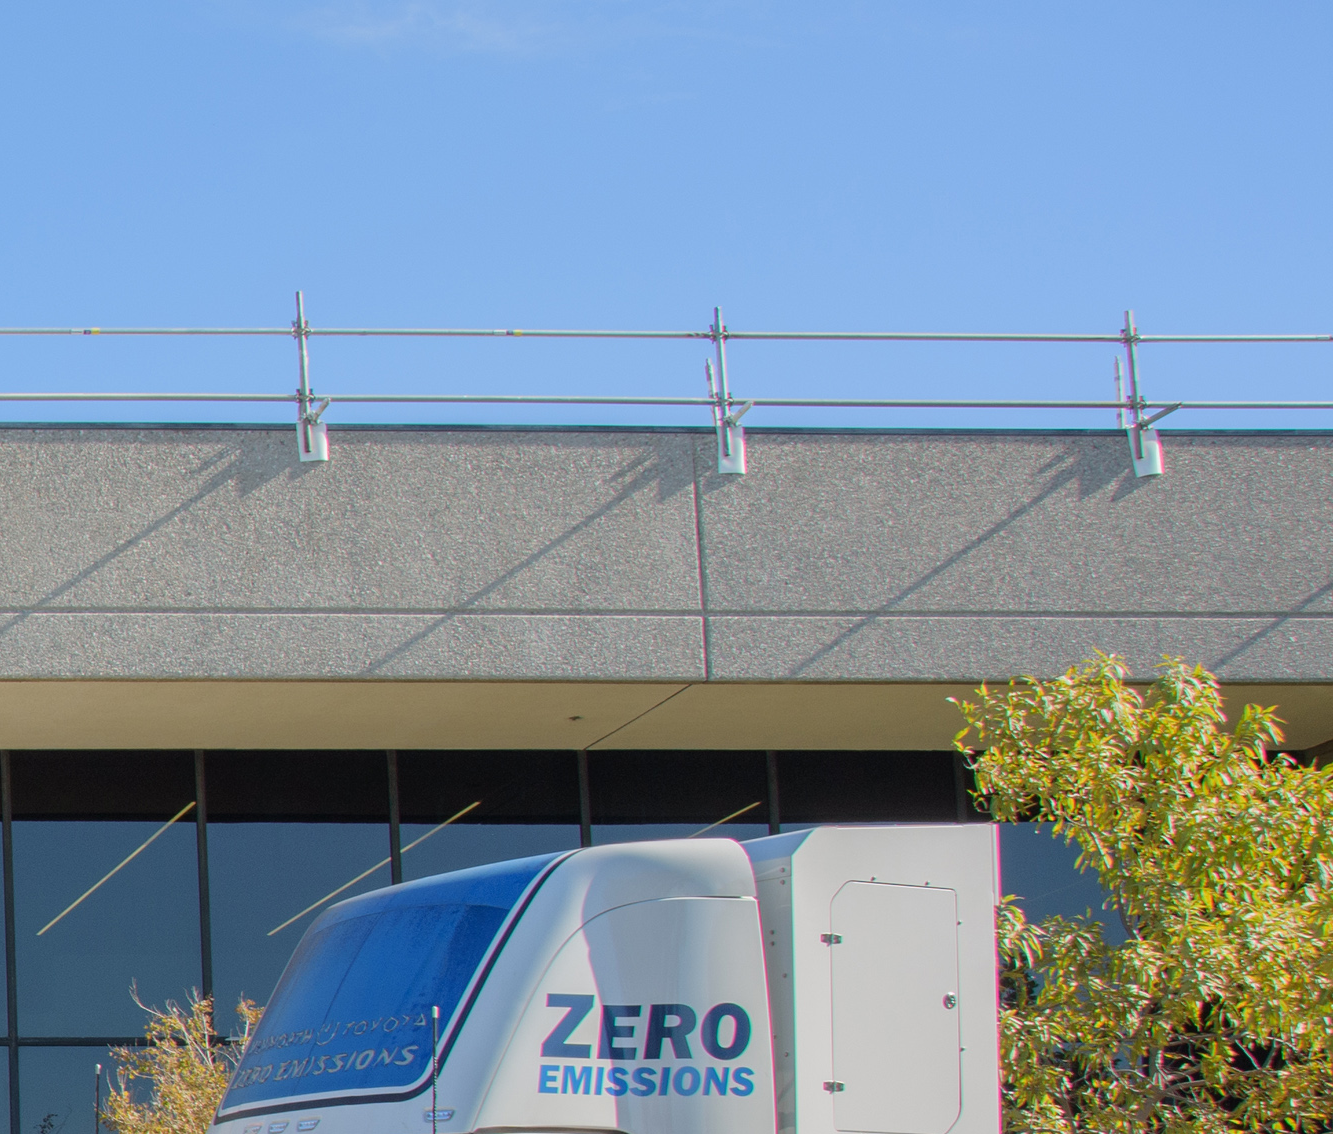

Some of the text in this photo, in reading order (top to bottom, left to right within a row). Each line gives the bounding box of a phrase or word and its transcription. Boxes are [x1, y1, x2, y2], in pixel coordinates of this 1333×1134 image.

[539, 993, 752, 1060] ZERO
[274, 1045, 419, 1081] EMISSIONS
[537, 1064, 755, 1097] EMISSIONS
